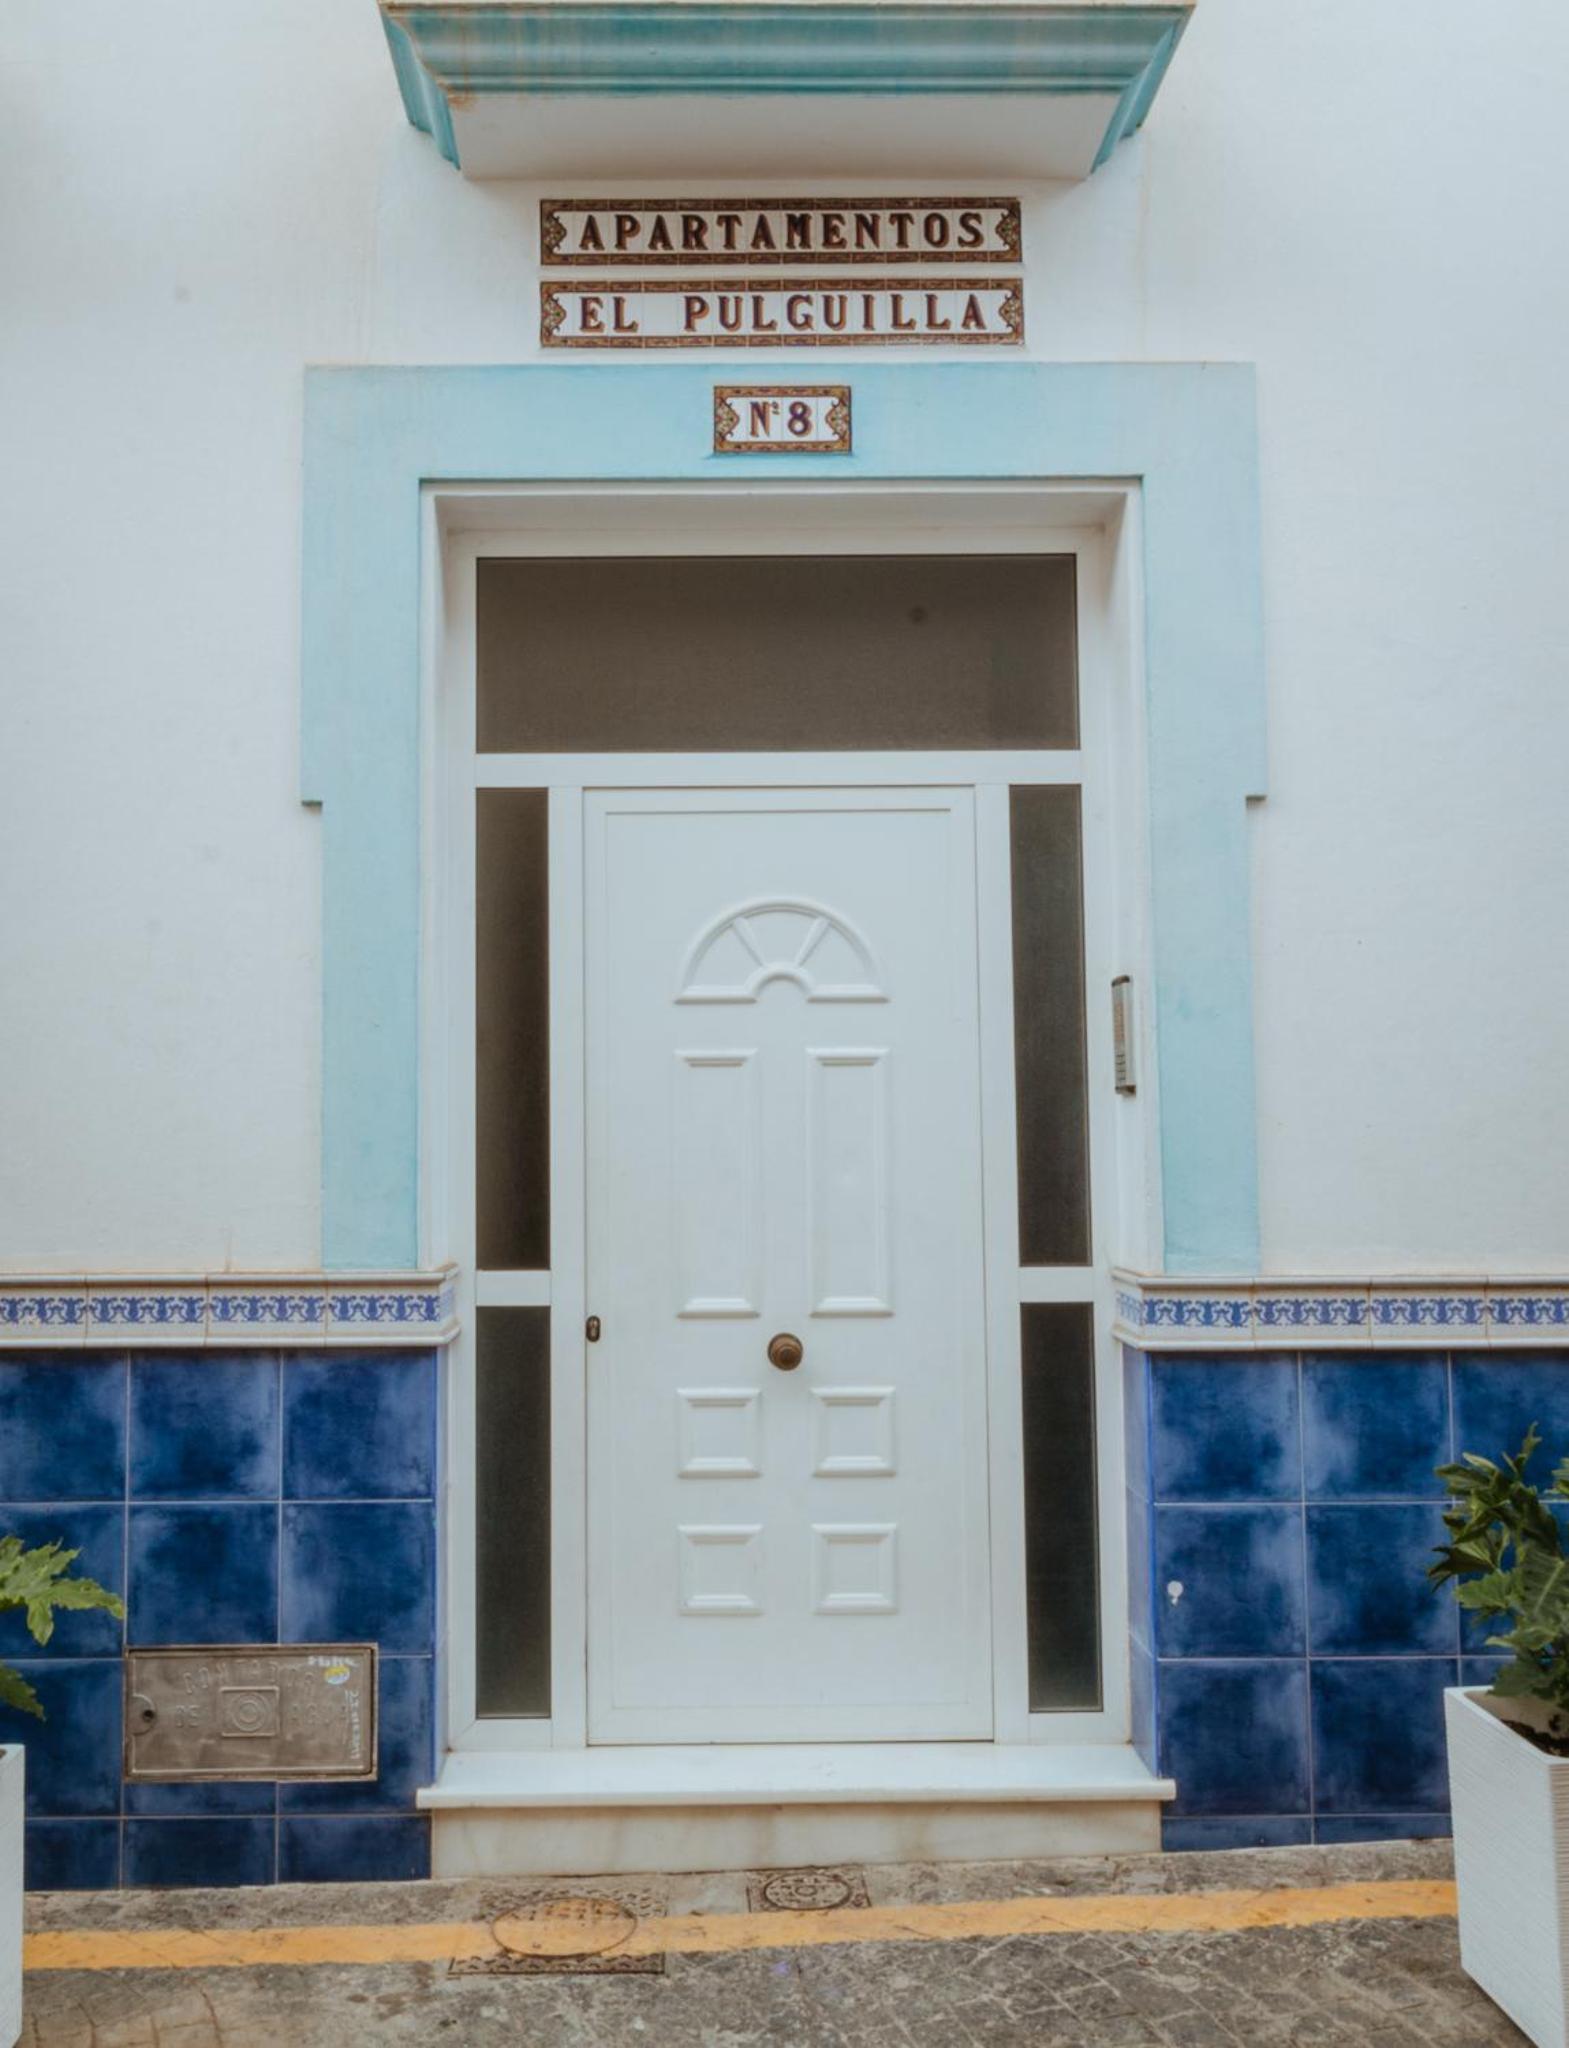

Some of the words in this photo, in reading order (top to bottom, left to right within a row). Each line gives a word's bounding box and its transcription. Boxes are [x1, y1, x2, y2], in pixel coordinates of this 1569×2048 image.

[579, 212, 984, 250] APARTAMENTOS
[579, 295, 639, 333] EL
[683, 293, 987, 332] PULGUILLA
[788, 401, 812, 436] 8
